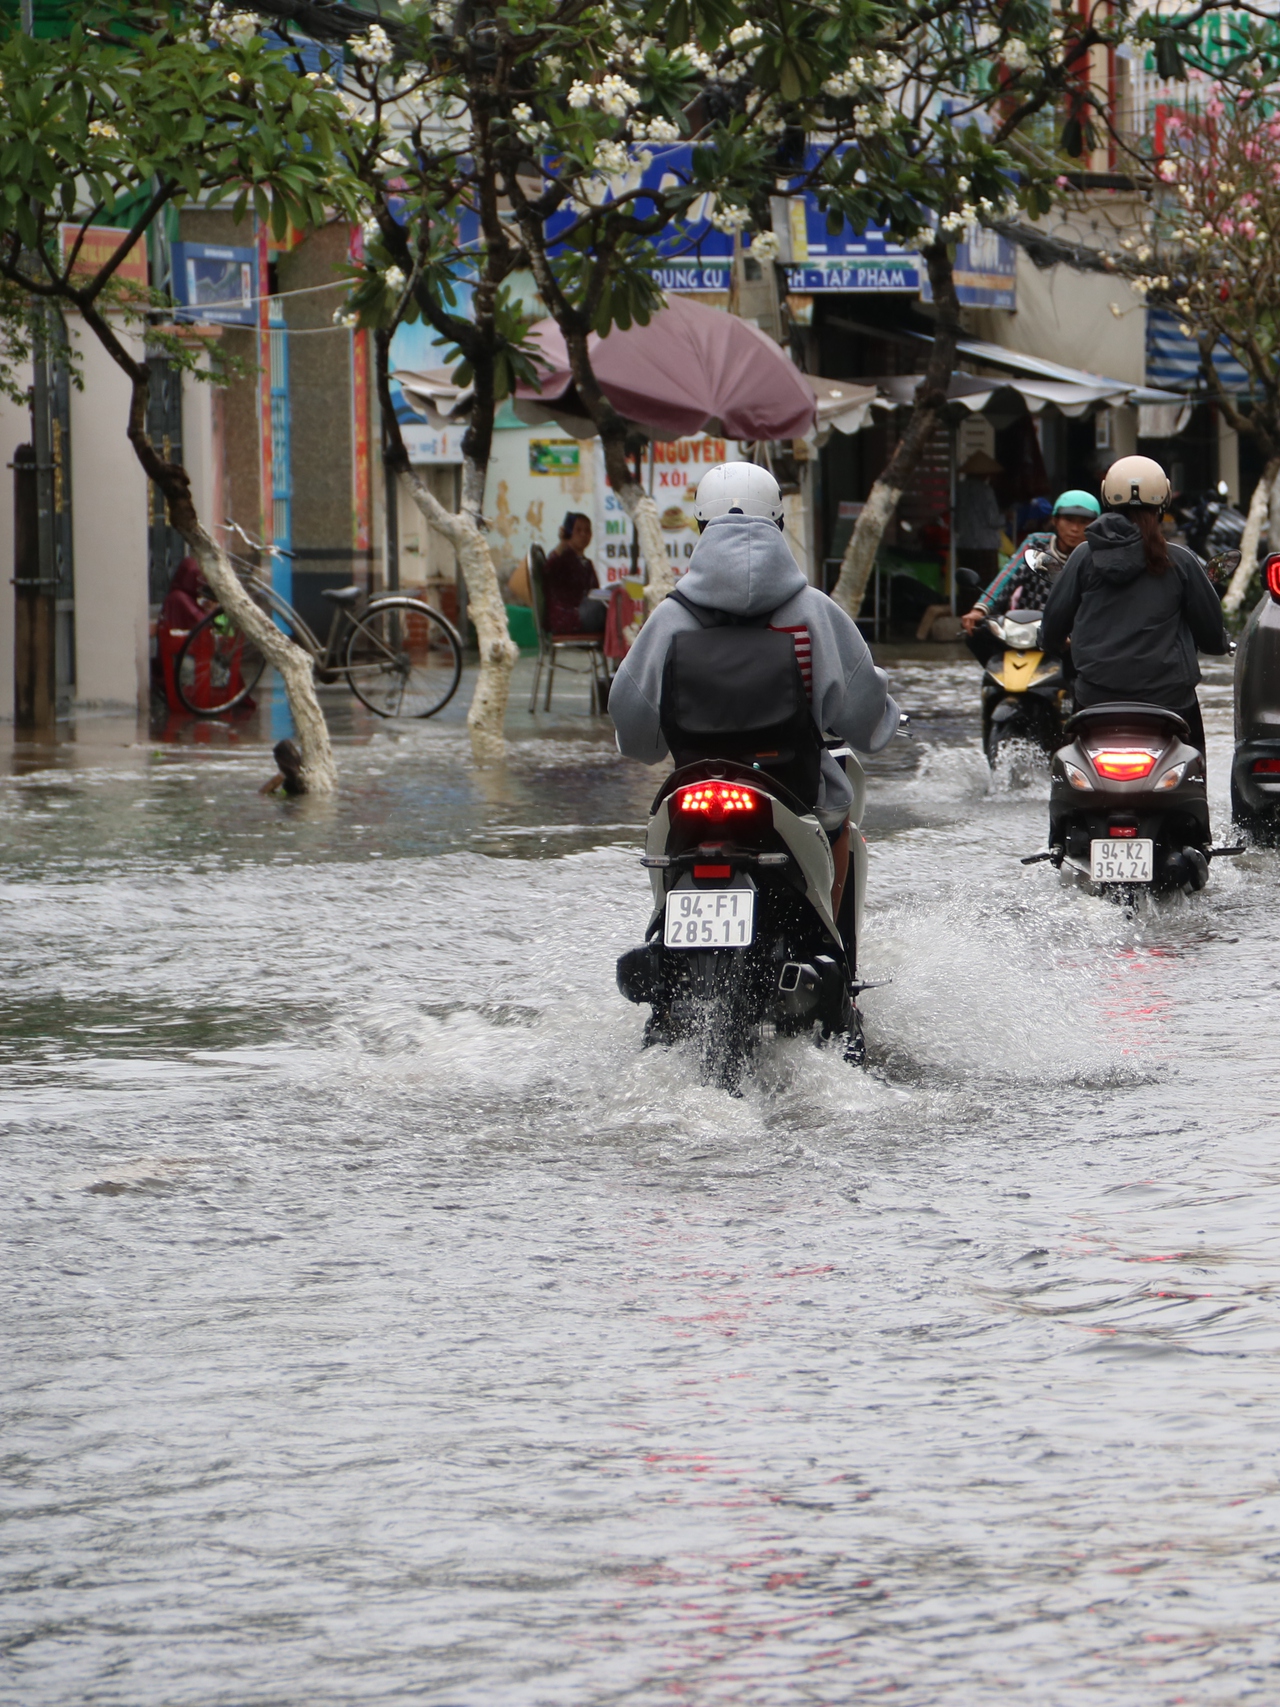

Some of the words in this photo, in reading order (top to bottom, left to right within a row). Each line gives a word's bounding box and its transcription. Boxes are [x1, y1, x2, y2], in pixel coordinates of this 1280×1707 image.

[659, 469, 688, 488] XÔI
[1101, 843, 1144, 860] 94-K2
[1095, 861, 1149, 879] 354.24
[680, 895, 738, 918] 94-F1
[670, 920, 746, 943] 285.11
